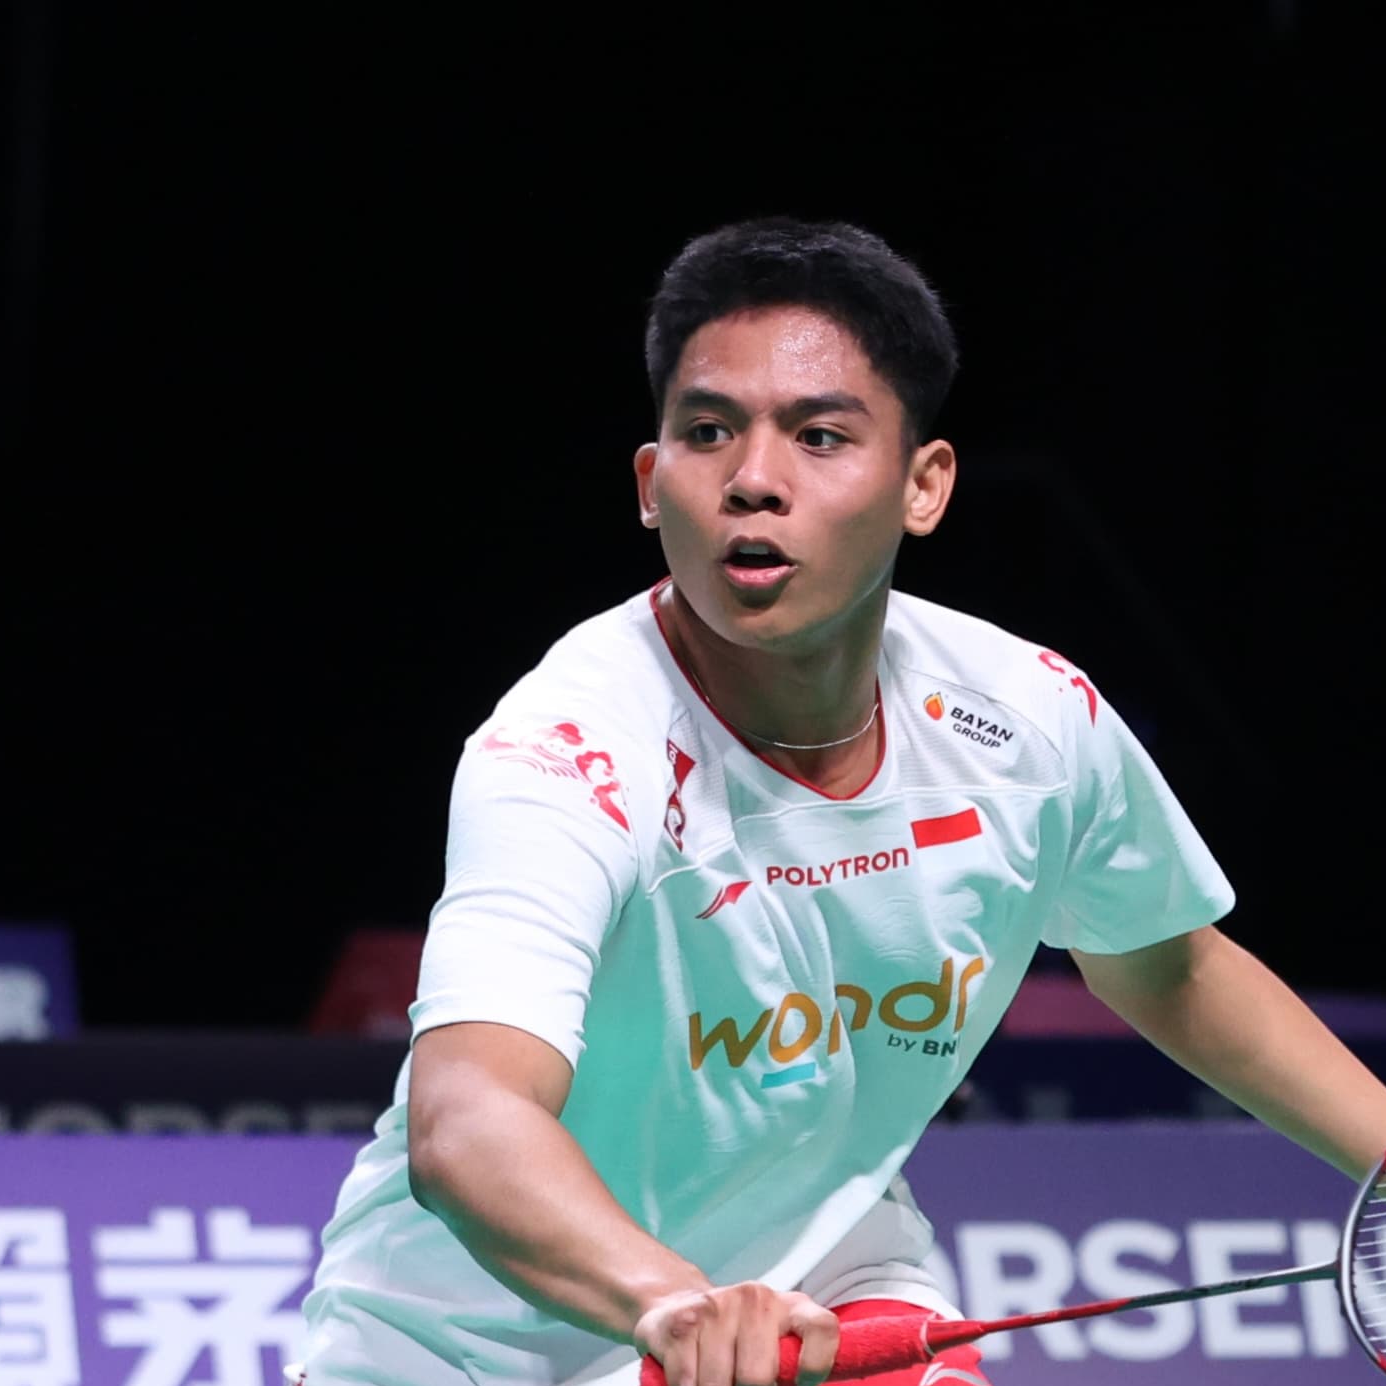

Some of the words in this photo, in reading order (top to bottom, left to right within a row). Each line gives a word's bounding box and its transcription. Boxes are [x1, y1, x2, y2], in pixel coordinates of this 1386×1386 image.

[950, 706, 1013, 742] BAYAN
[952, 722, 1002, 750] GROUP
[688, 956, 985, 1071] wondr
[886, 1033, 918, 1052] by
[922, 1036, 961, 1057] BN
